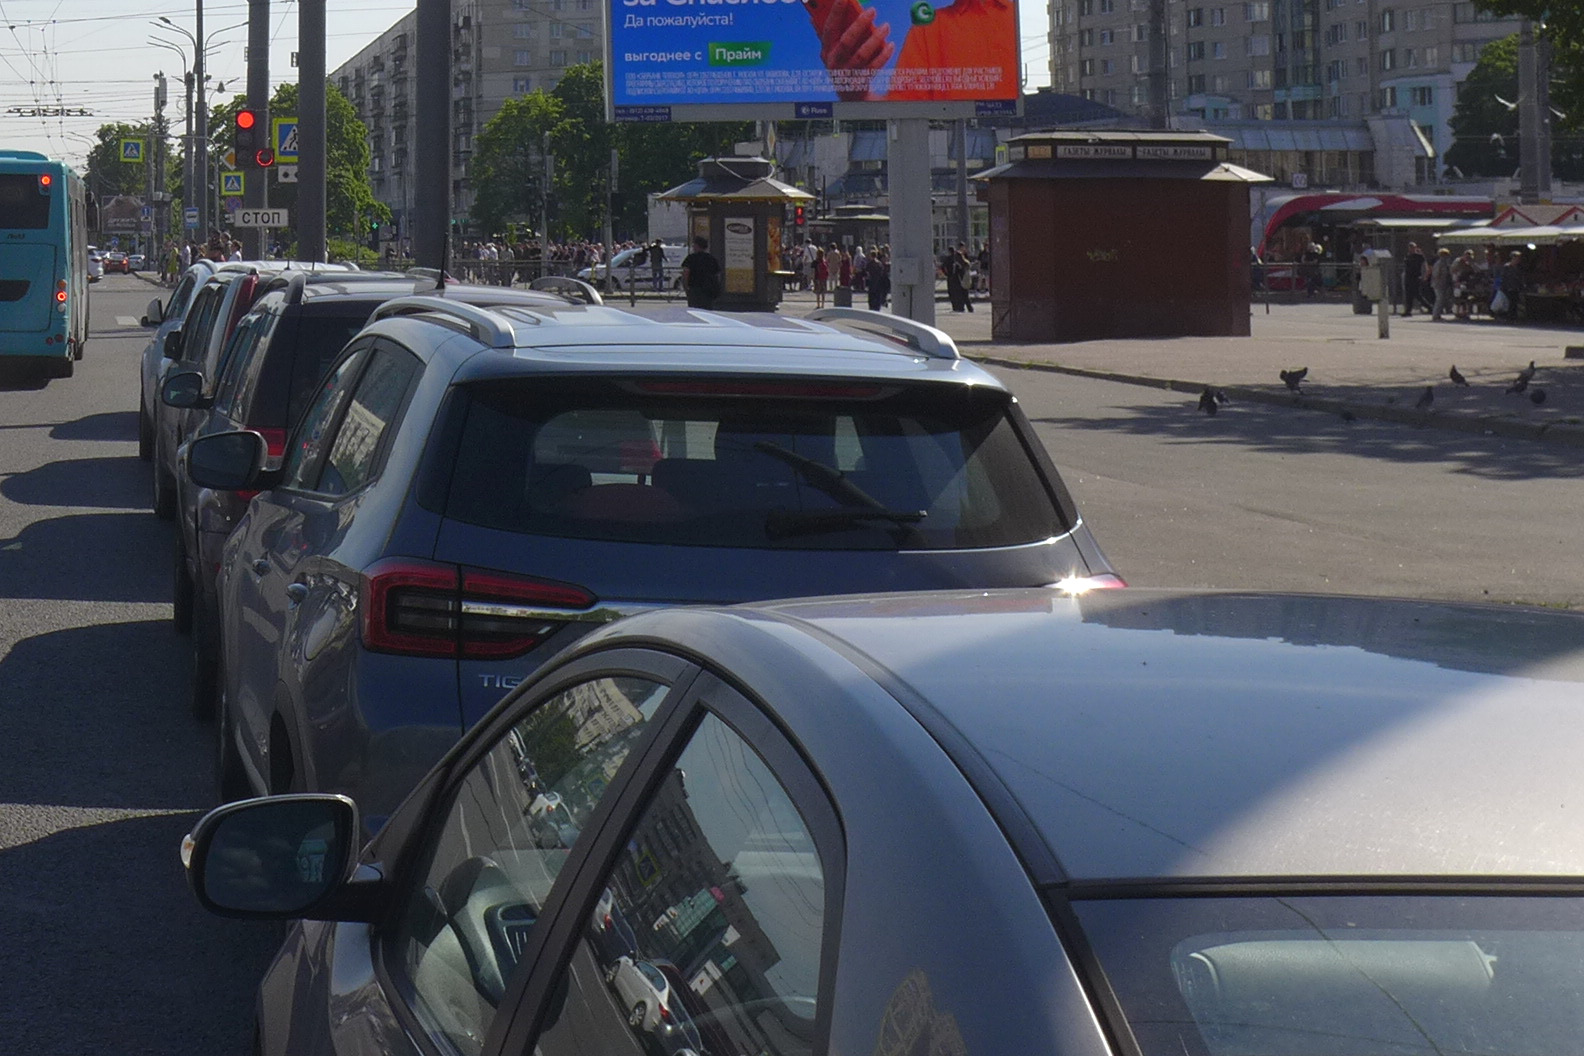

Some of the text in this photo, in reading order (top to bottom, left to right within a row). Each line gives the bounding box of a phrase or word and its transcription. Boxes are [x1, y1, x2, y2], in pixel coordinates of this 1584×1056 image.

[624, 13, 734, 28] Да пожалуйста!
[625, 47, 762, 62] выгоднее с Прайм
[242, 212, 280, 224] СТОП
[478, 674, 523, 689] TIG
